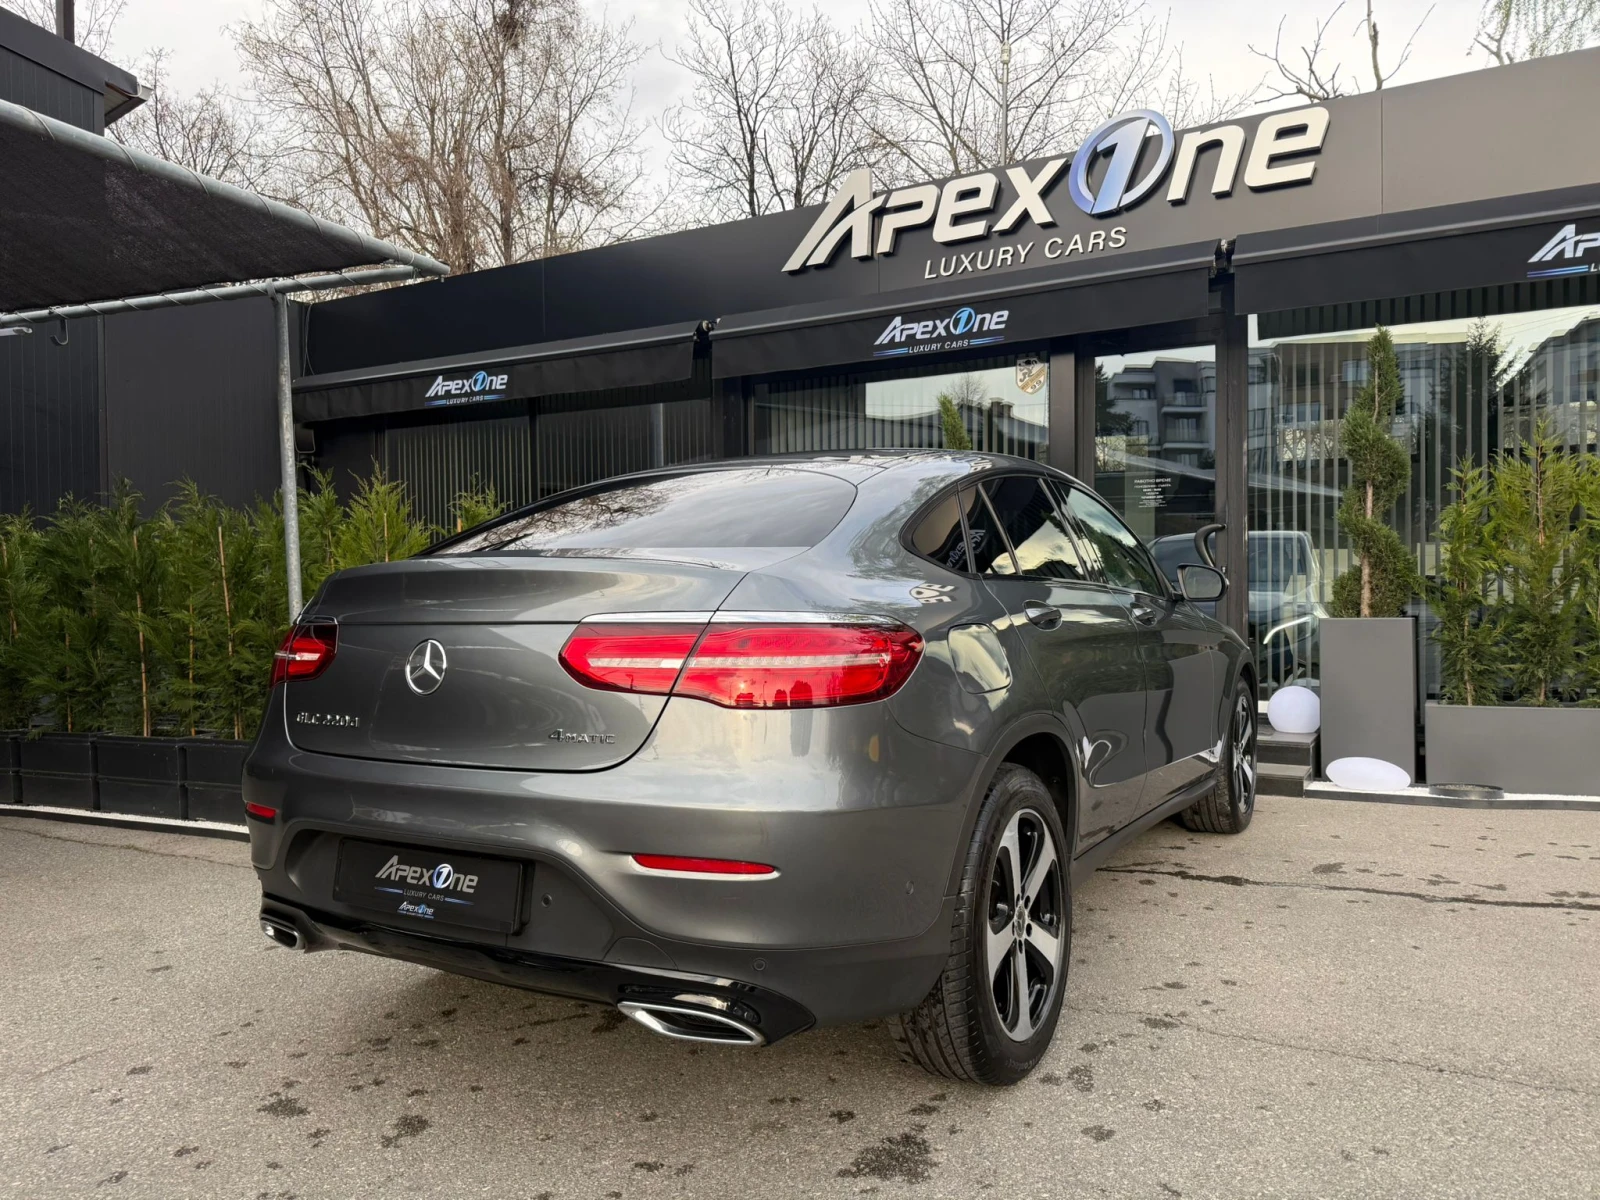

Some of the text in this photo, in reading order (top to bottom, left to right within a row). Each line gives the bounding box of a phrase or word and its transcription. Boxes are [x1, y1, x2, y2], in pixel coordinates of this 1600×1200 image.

[924, 226, 1128, 279] LUXURY CARS
[909, 339, 969, 354] LUXURY CARS
[548, 728, 616, 745] 4MATIC
[404, 888, 444, 901] LUXURY CARS
